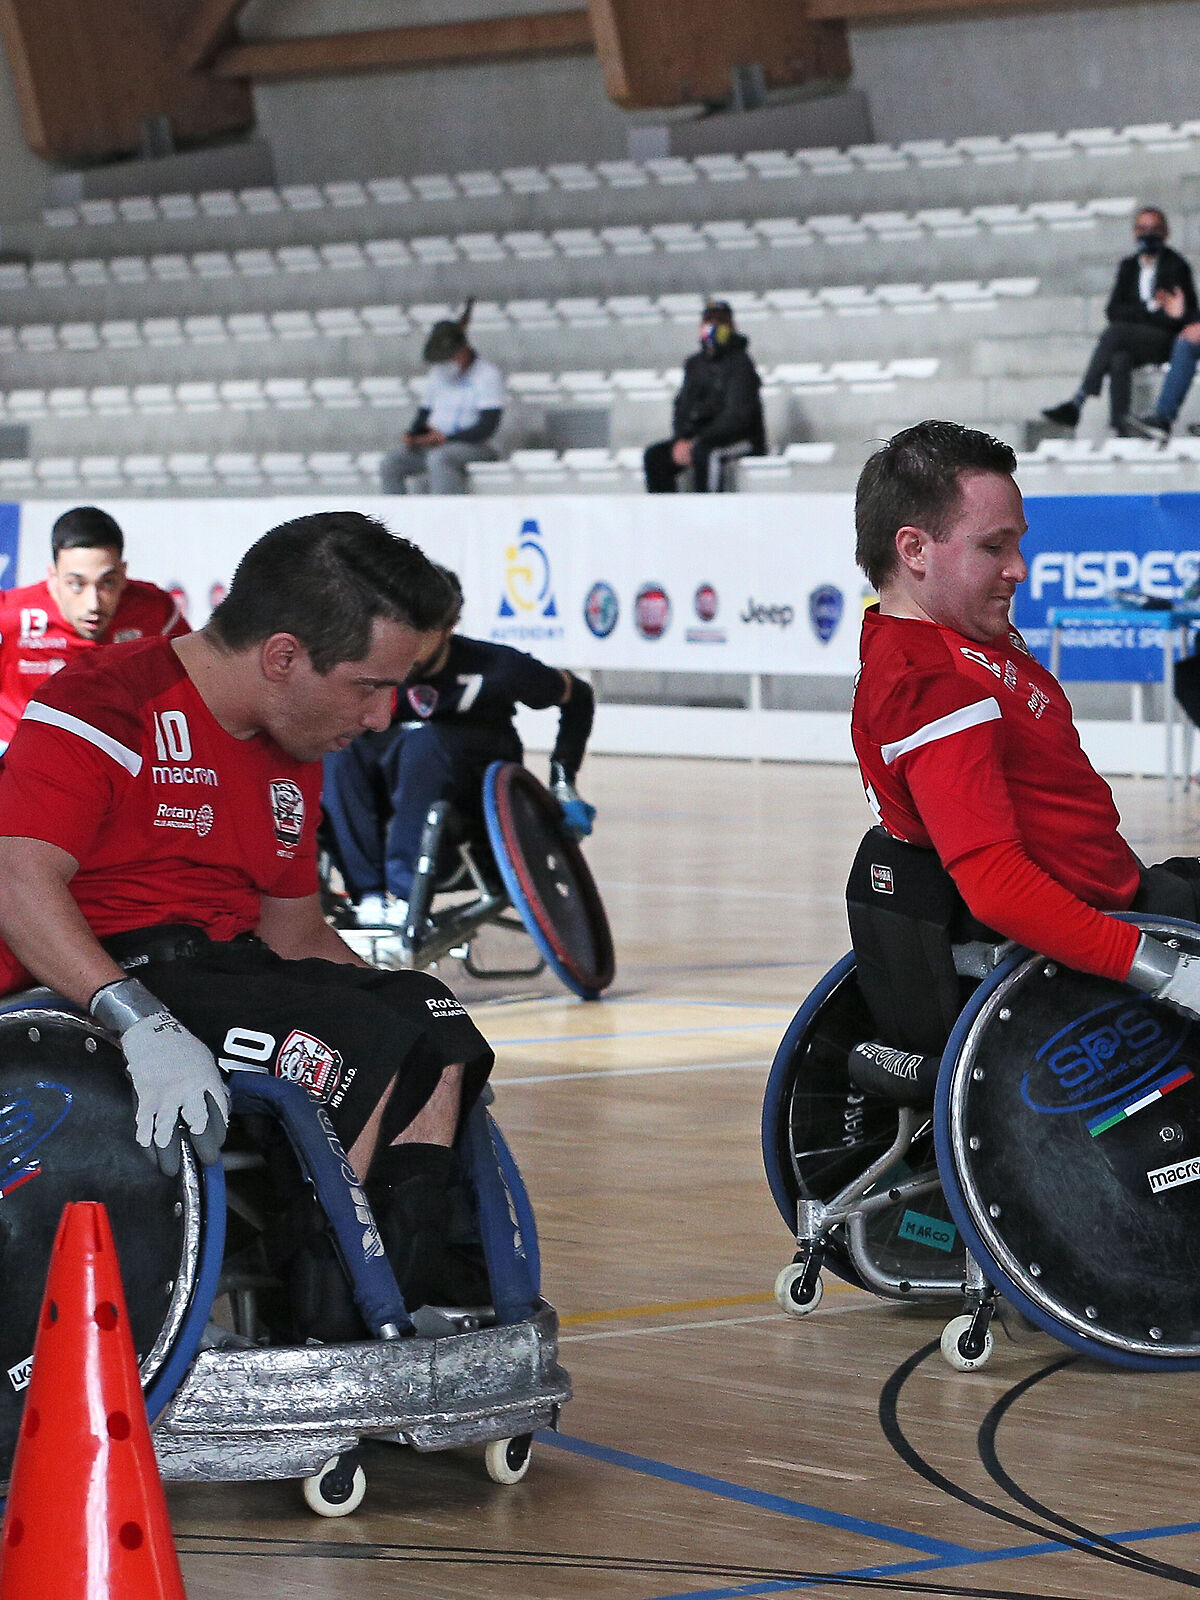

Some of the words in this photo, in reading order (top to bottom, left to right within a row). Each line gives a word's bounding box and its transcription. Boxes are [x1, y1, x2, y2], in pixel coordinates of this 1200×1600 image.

[1031, 551, 1199, 600] FISPES
[21, 608, 48, 639] 13
[741, 597, 794, 629] Jeep
[457, 674, 483, 714] 7
[153, 710, 192, 762] 10
[151, 765, 219, 788] macron
[156, 803, 198, 822] Rotary
[424, 997, 462, 1011] Rota
[218, 1027, 277, 1076] 10
[1048, 1010, 1163, 1089] SPS
[330, 1090, 346, 1109] H81
[905, 1221, 950, 1243] MARCO
